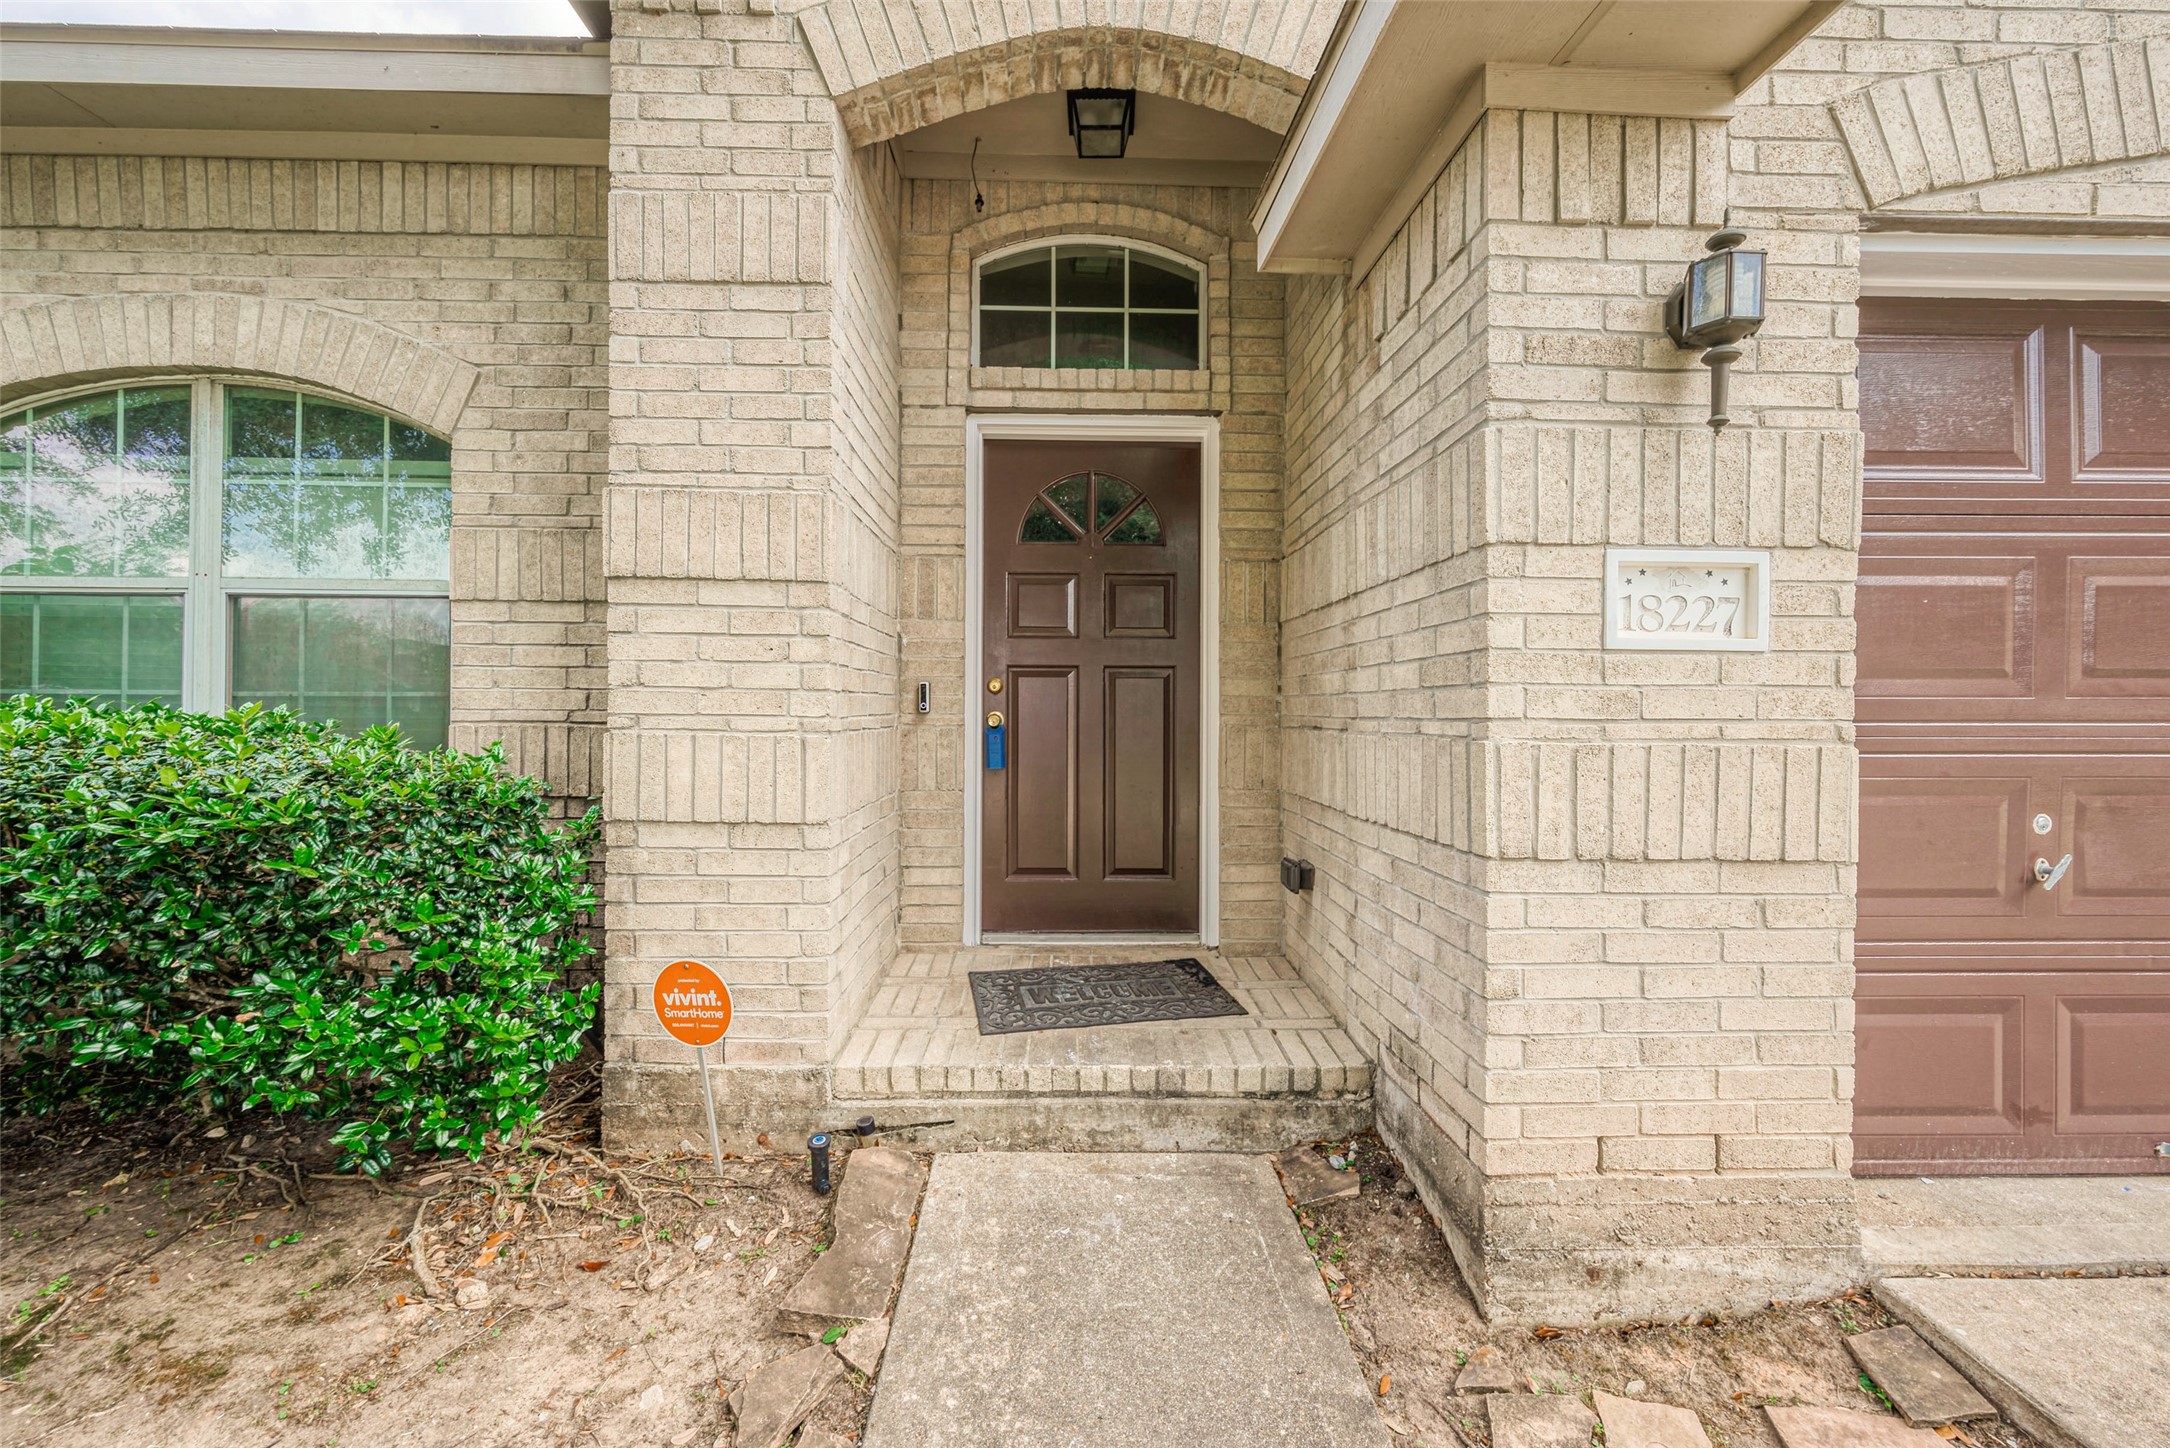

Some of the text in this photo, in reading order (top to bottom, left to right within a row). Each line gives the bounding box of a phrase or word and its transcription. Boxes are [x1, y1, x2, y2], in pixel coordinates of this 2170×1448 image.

[1619, 594, 1740, 637] 18227
[662, 988, 722, 1006] vivint.
[1027, 980, 1176, 1004] WELCOME
[664, 1007, 724, 1019] SmartHome
